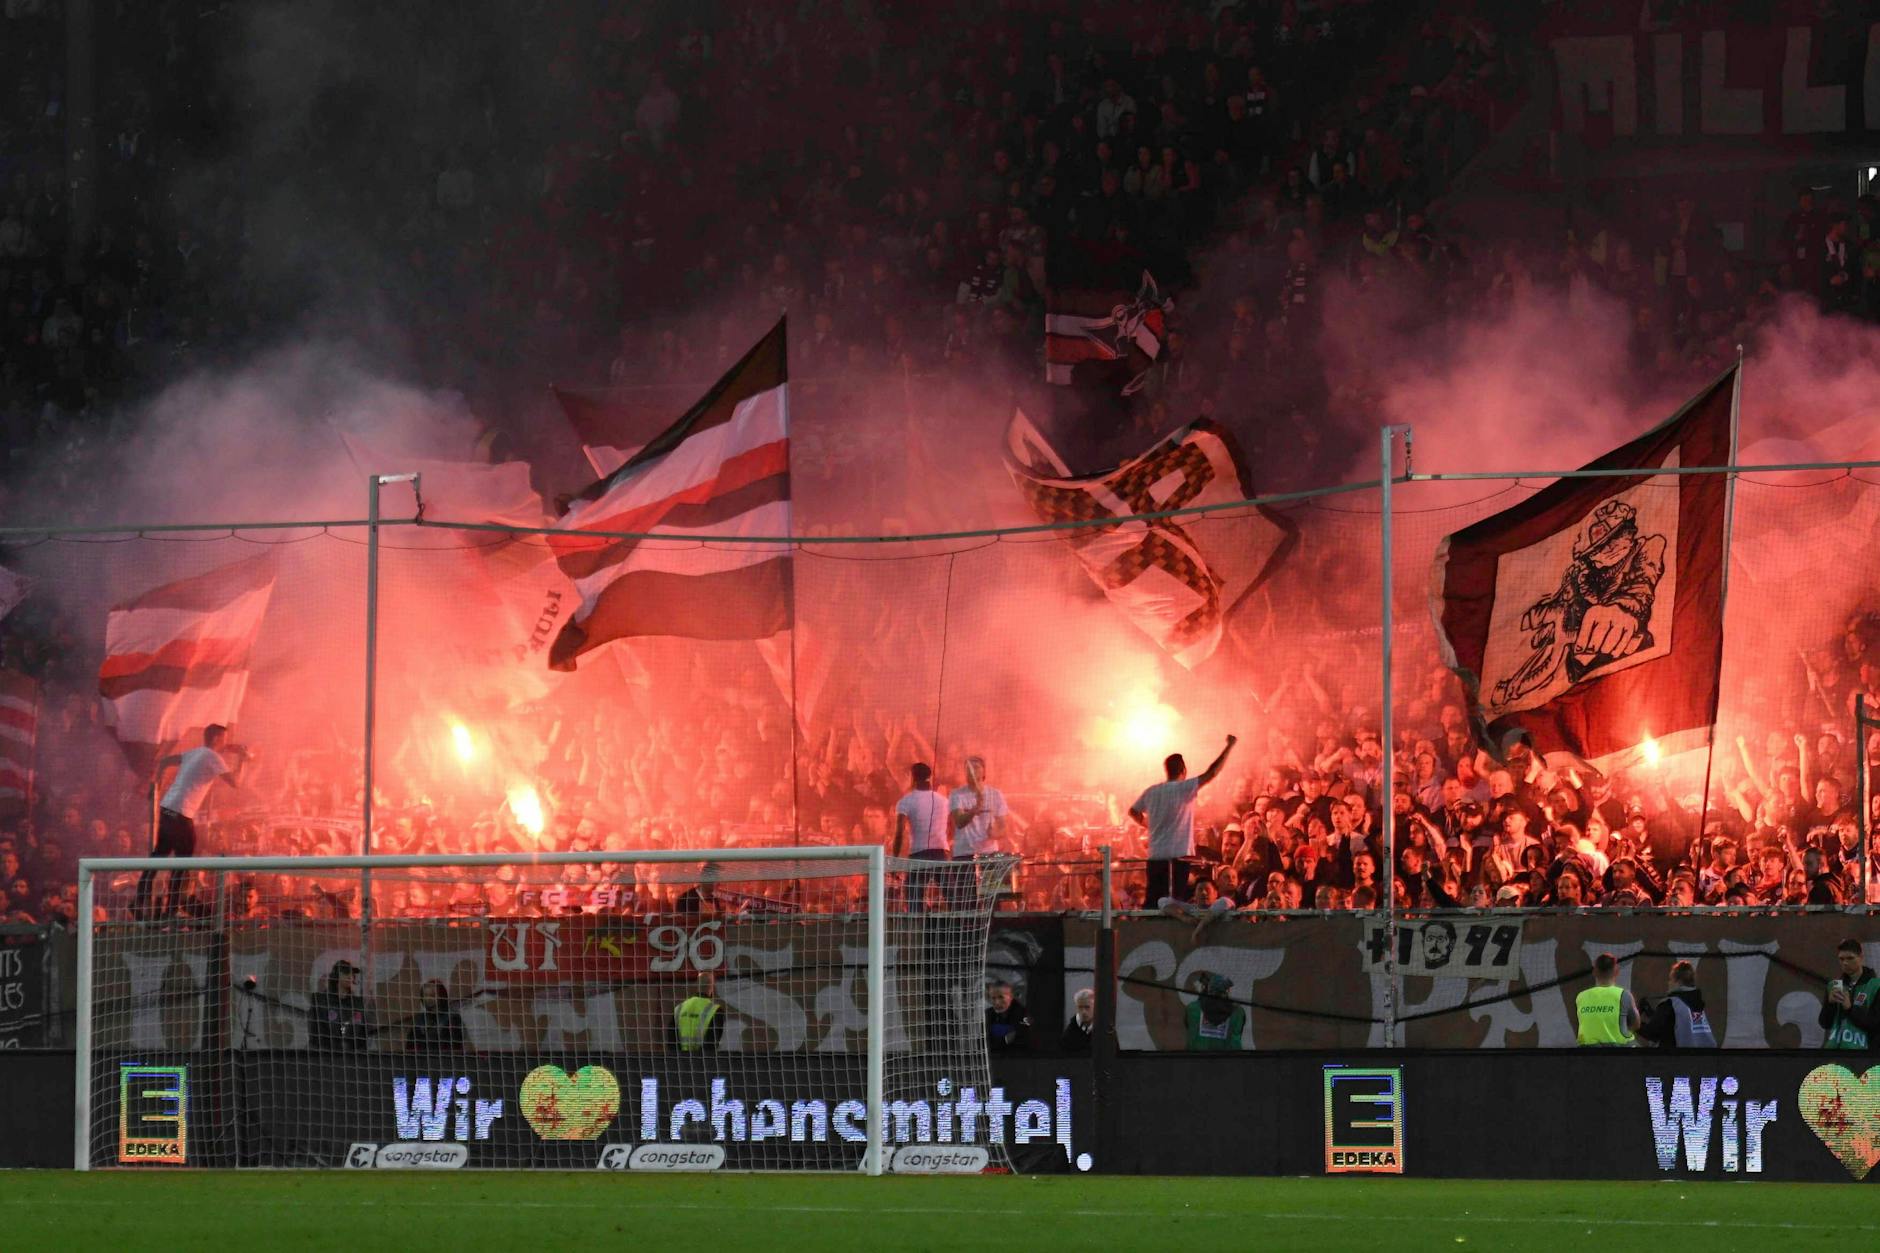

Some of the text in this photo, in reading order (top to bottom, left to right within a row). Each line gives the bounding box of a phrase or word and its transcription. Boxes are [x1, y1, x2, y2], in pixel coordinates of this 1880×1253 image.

[1580, 1005, 1615, 1015] ORDNER
[392, 1077, 503, 1141] Wir
[1645, 1076, 1778, 1173] Wir
[125, 1143, 180, 1156] EDEKA
[385, 1149, 459, 1165] congstar
[640, 1150, 716, 1168] congstar
[903, 1152, 980, 1170] congstar
[1332, 1152, 1396, 1166] EDEKA
